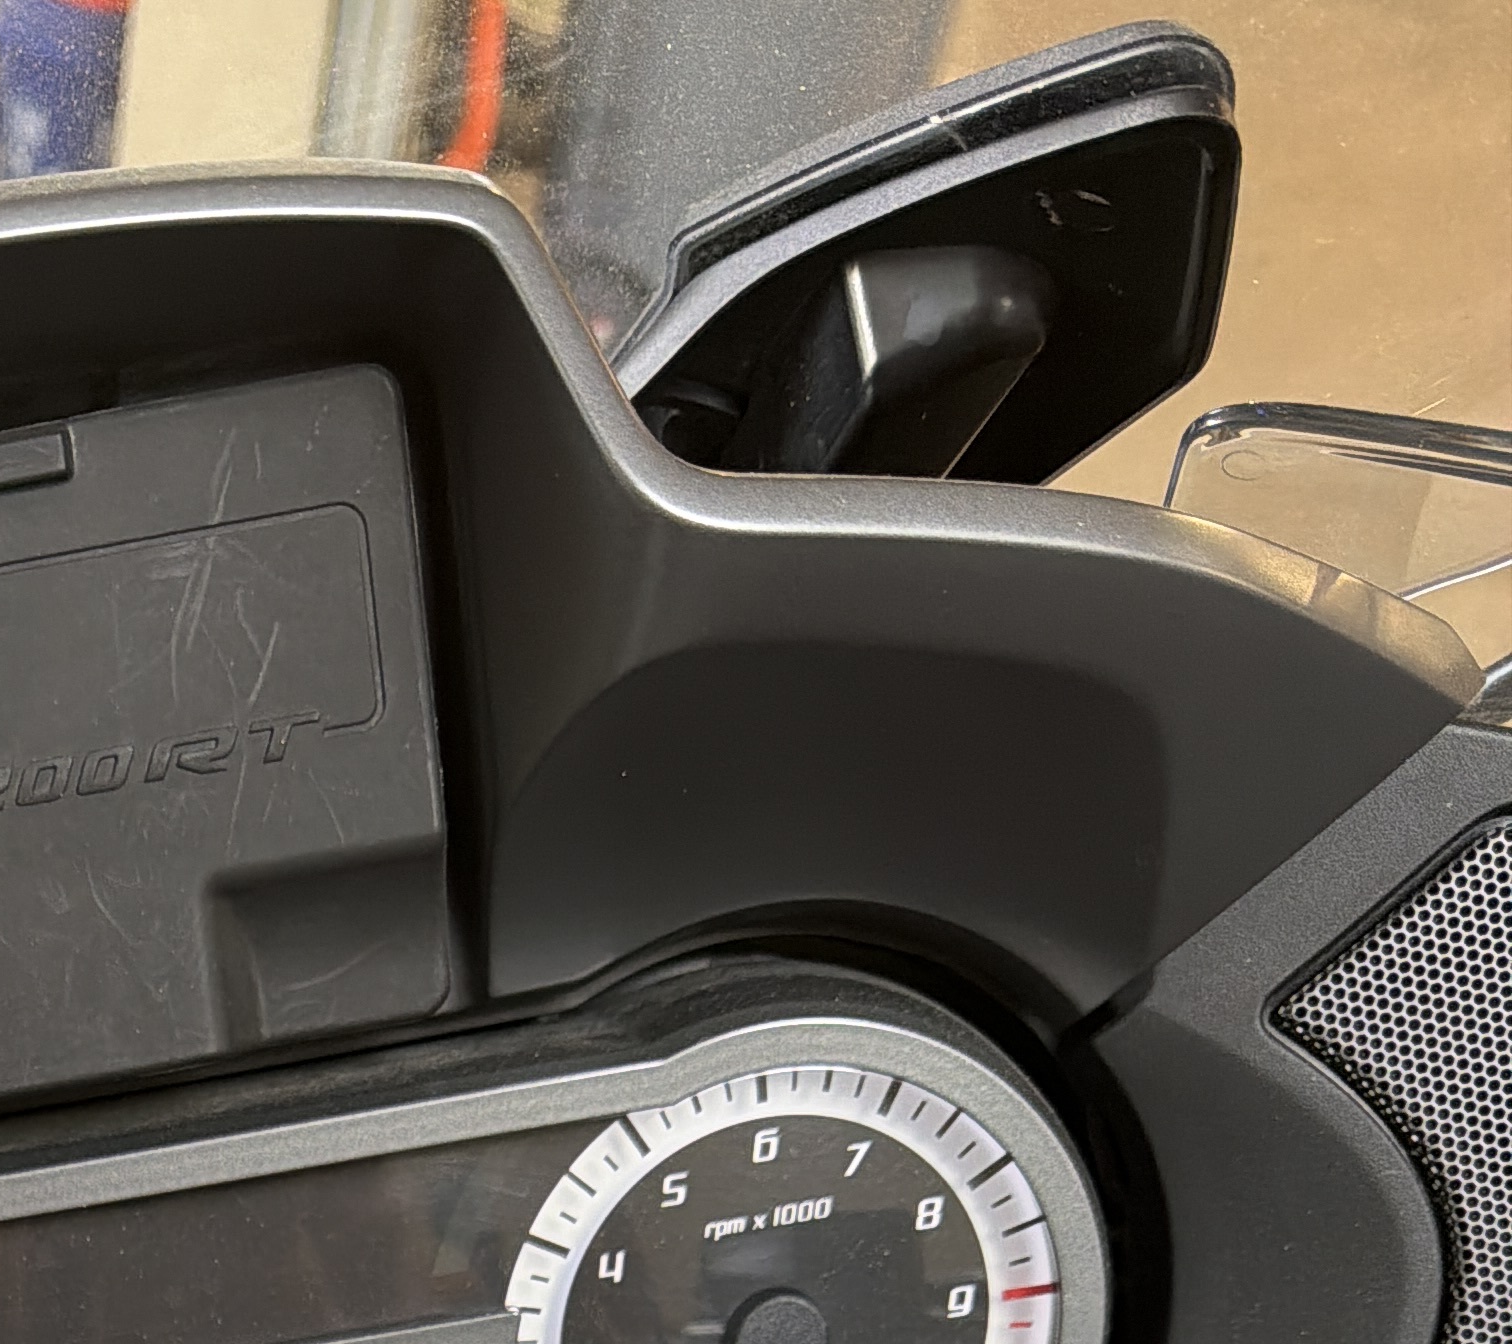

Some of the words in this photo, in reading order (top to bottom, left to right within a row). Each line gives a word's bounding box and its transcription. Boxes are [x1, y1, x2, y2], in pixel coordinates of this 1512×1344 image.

[752, 1127, 780, 1164] 6
[843, 1140, 872, 1177] 7
[660, 1171, 688, 1208] 5
[703, 1215, 746, 1241] rpm
[752, 1215, 765, 1230] x
[772, 1196, 834, 1228] 1000
[914, 1195, 944, 1231] 8
[599, 1250, 625, 1283] 4
[946, 1285, 975, 1319] 9
